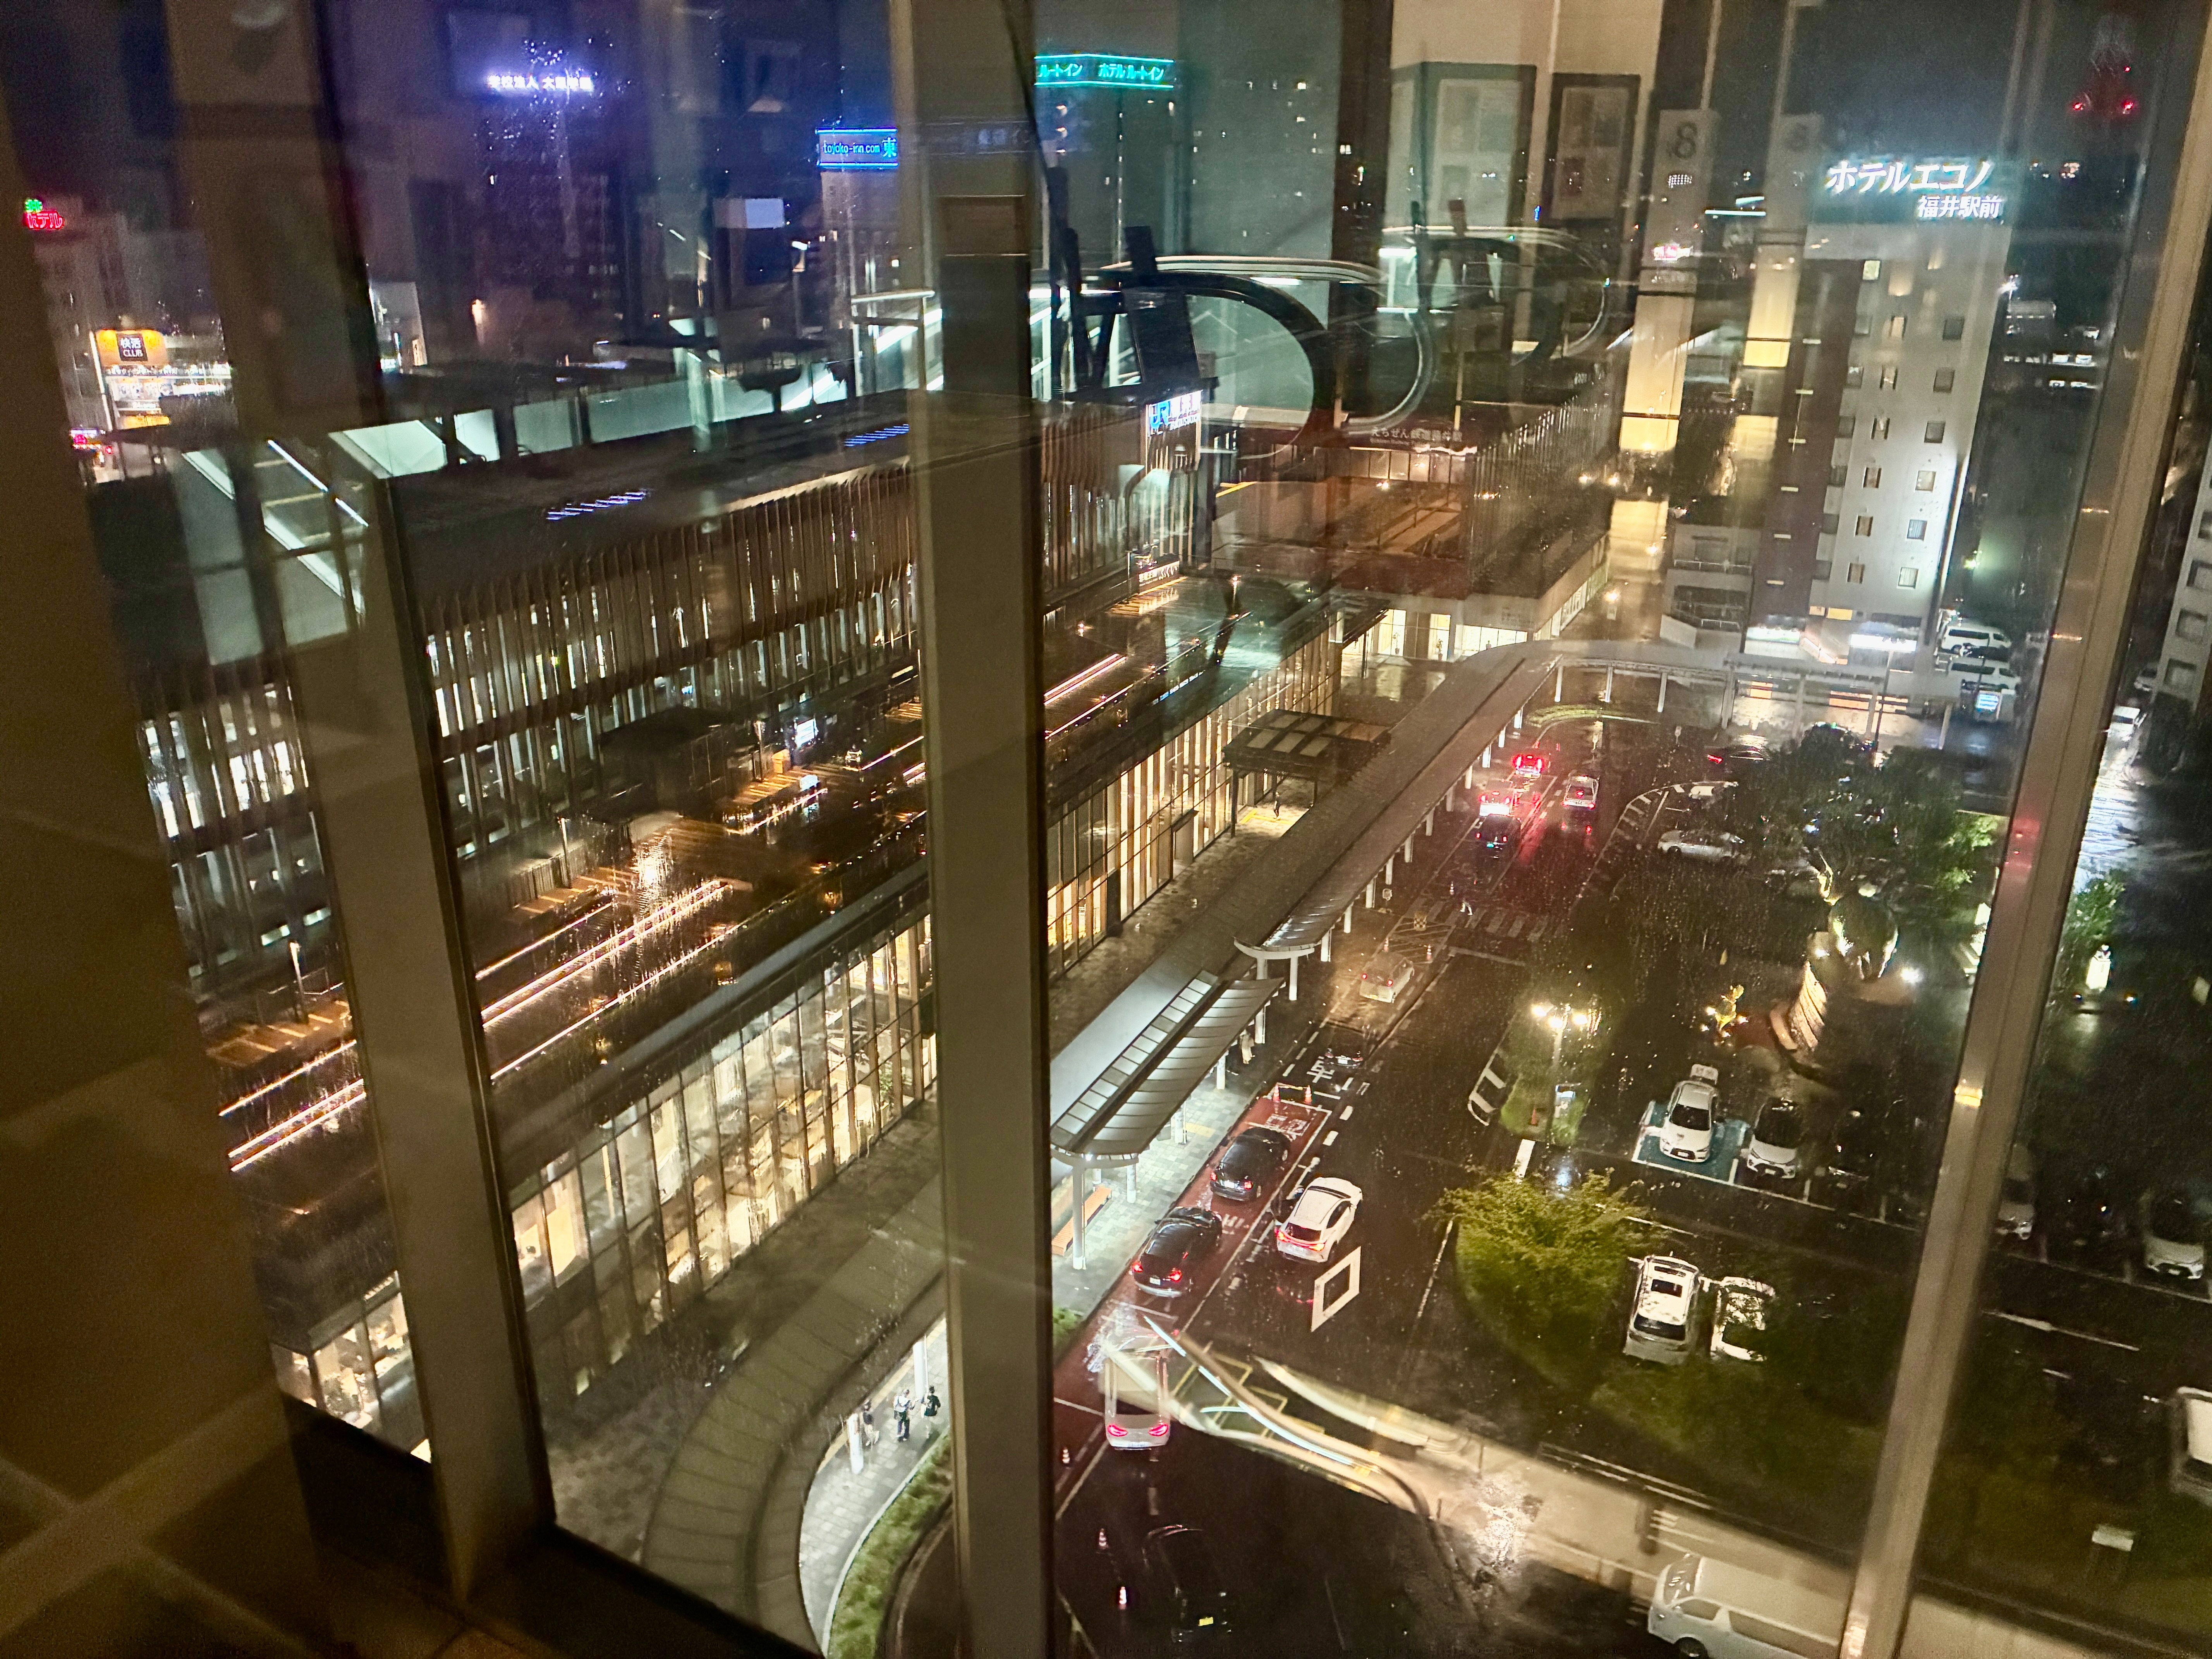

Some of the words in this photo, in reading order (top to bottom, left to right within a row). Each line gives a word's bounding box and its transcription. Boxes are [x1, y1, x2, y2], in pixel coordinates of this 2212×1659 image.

[1039, 63, 1083, 77] ルートイン
[823, 141, 880, 156] toyoko-inn.com
[882, 137, 897, 158] 東
[1825, 161, 1991, 194] ホテルエコノ
[1918, 196, 2002, 218] 福井駅前
[27, 213, 63, 228] ホテル
